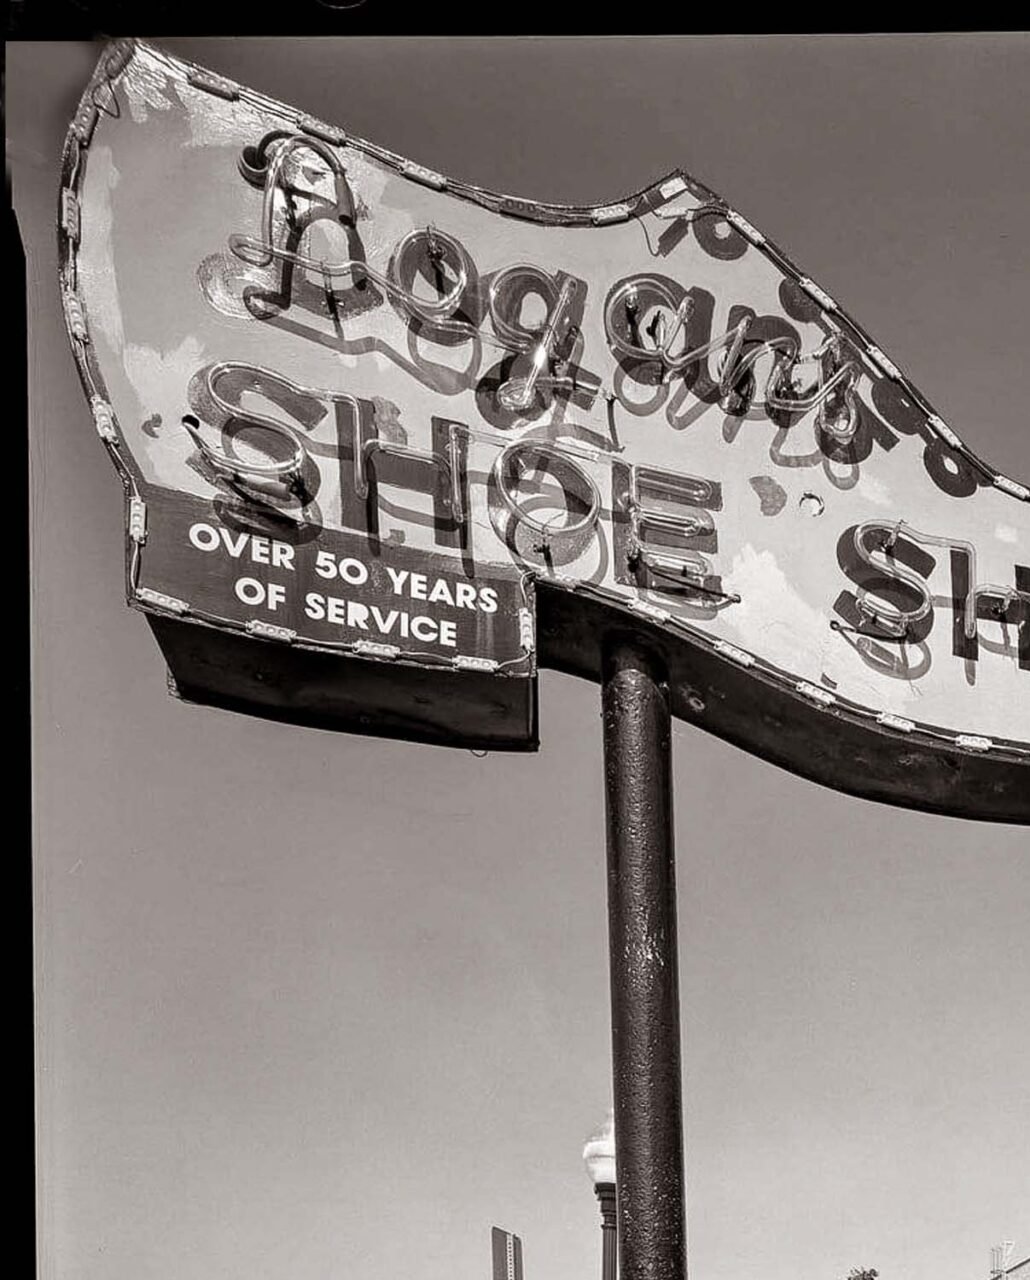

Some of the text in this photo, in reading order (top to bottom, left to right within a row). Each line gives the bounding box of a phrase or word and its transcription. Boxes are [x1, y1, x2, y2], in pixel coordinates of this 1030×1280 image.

[187, 361, 723, 604] SHOE
[189, 523, 499, 614] OVER 50 YEARS
[235, 577, 458, 648] OF SERVICE
